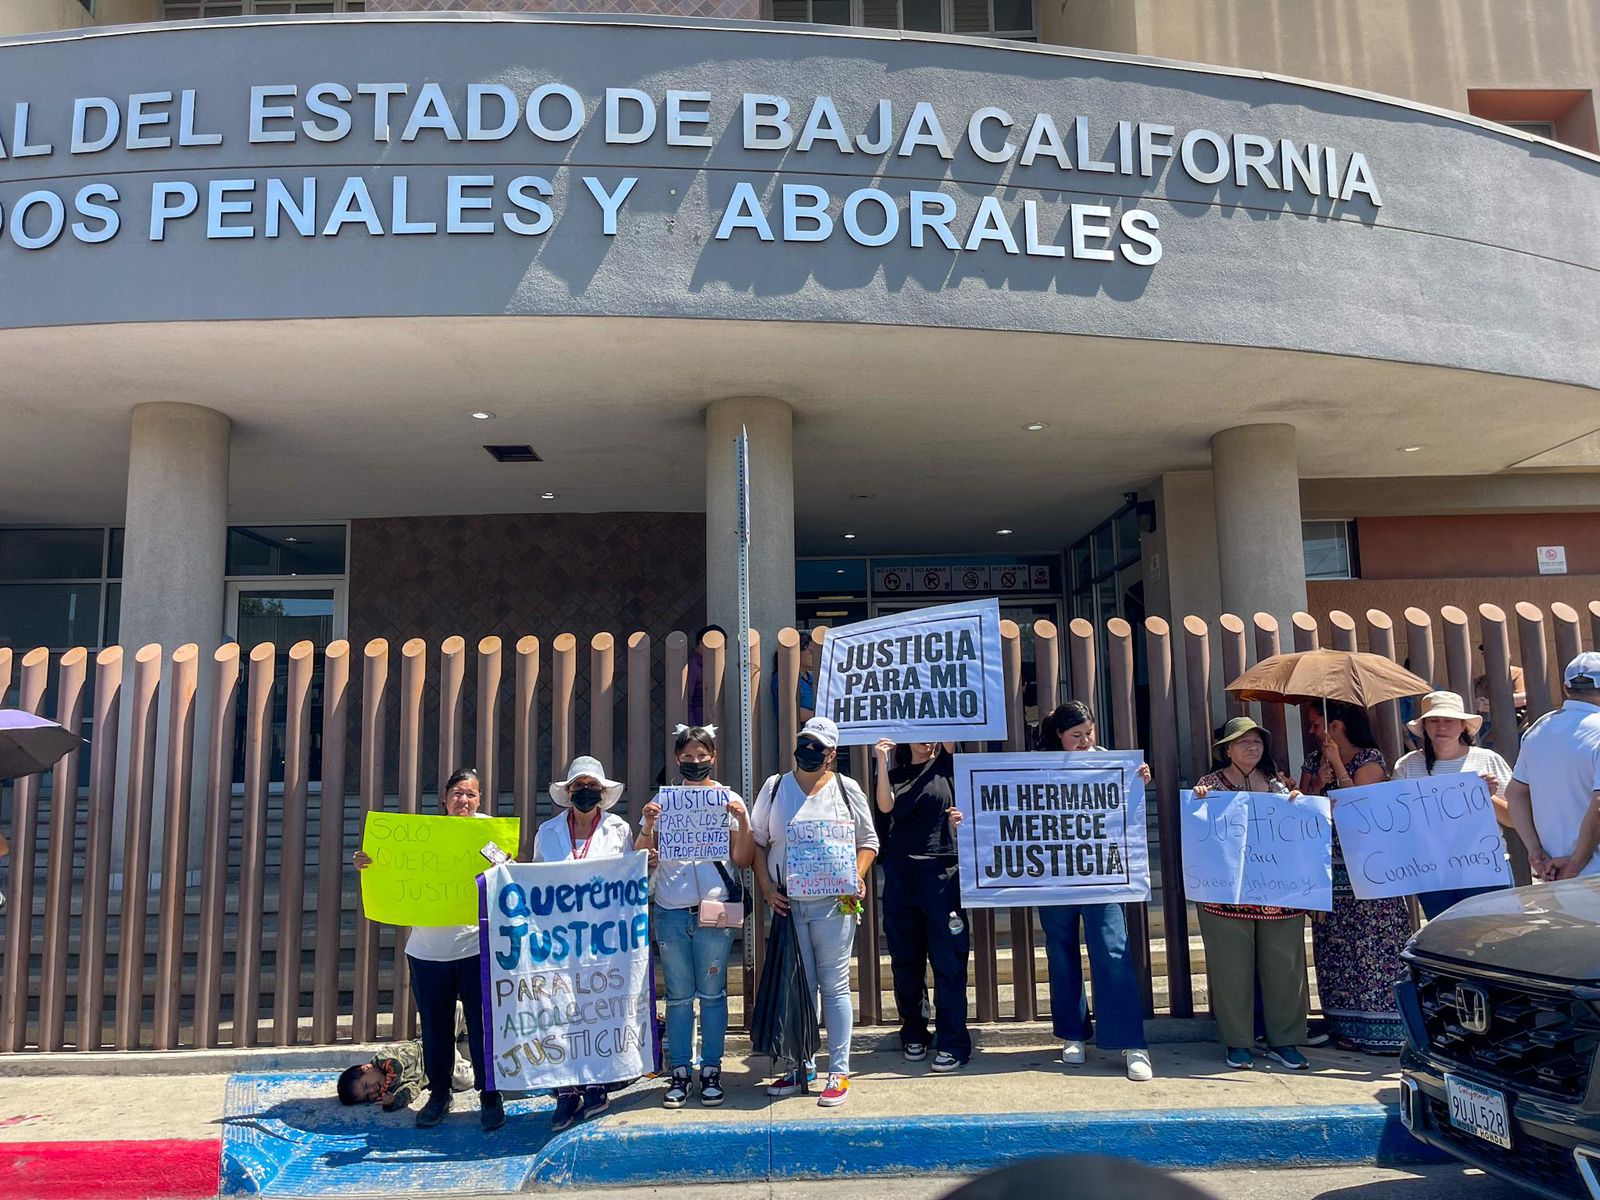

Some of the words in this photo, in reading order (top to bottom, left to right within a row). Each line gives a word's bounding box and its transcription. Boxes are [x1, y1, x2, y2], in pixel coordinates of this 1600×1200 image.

[0, 102, 53, 160] L
[71, 89, 223, 155] DEL
[249, 82, 586, 144] ESTADO
[605, 87, 712, 149] DE
[742, 93, 954, 160] BAJA
[967, 106, 1383, 207] CALIFORNIA
[0, 182, 120, 250] OS
[149, 175, 555, 241] PENALES
[582, 177, 639, 236] Y
[715, 182, 1164, 267] ABORALES
[837, 629, 976, 674] JUSTICIA
[845, 667, 921, 695] PARA
[930, 663, 967, 689] MI
[834, 689, 978, 723] HERMANO
[660, 790, 729, 812] JUSTICIA
[980, 784, 1009, 812] MI
[1017, 782, 1120, 810] HERMANO
[369, 817, 430, 842] SOLO
[660, 813, 696, 830] PARA
[699, 813, 718, 826] LOS
[720, 812, 729, 828] 2
[786, 824, 855, 842] JUSTICIA
[1000, 812, 1107, 842] MERECE
[797, 862, 847, 874] JUSTICIA
[984, 843, 1124, 879] JUSTICIA
[801, 877, 843, 887] JUSTICIA
[496, 975, 571, 1007] PARA
[576, 967, 625, 994] LOS
[1452, 1095, 1505, 1137] 9UJL528
